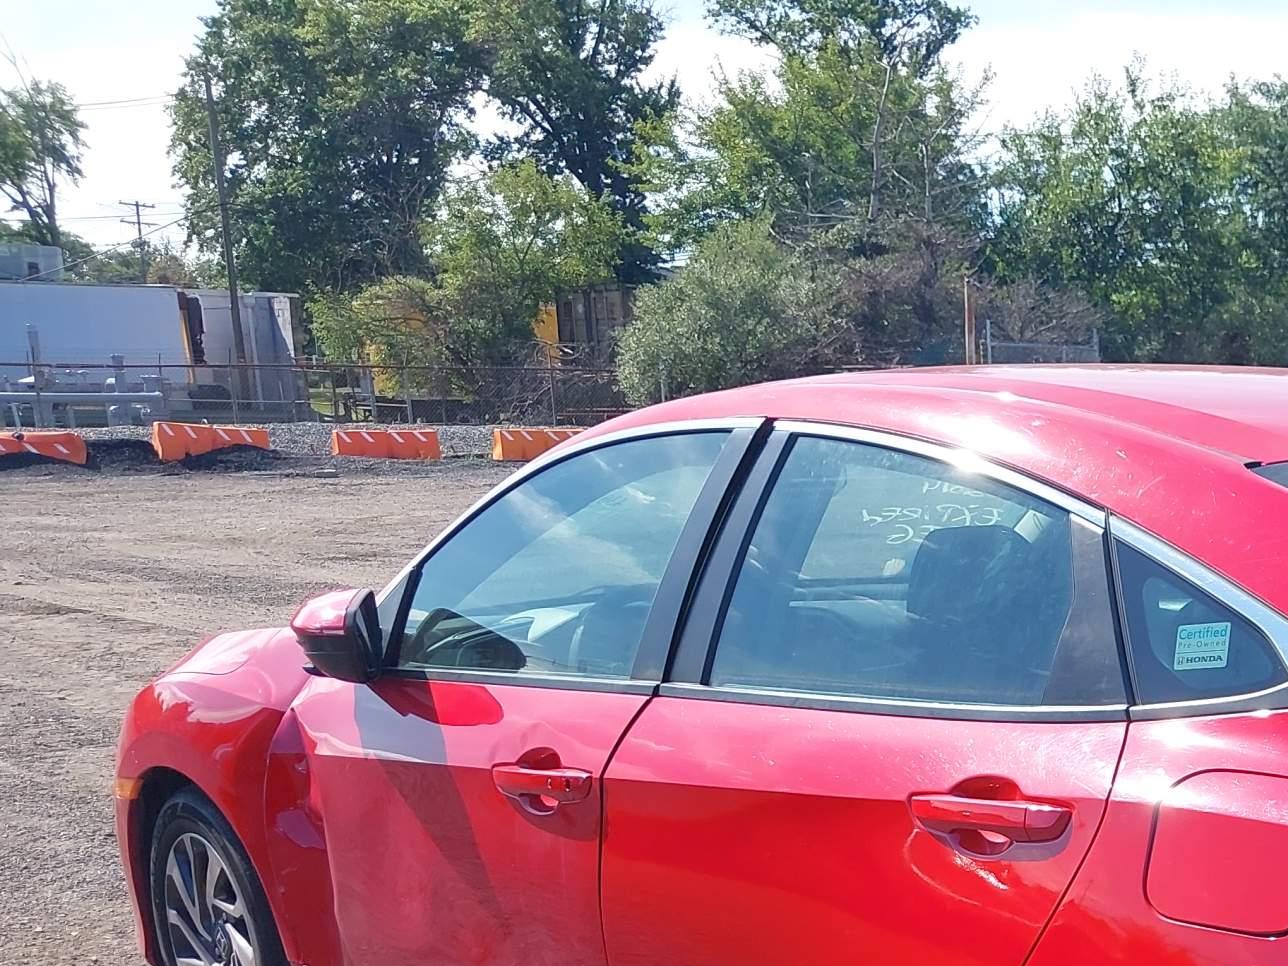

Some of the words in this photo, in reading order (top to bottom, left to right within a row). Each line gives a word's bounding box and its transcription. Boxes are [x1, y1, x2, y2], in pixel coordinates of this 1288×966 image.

[1179, 625, 1228, 639] Certified
[1178, 640, 1226, 648] Pre-Owned
[1186, 655, 1223, 664] HONDA
